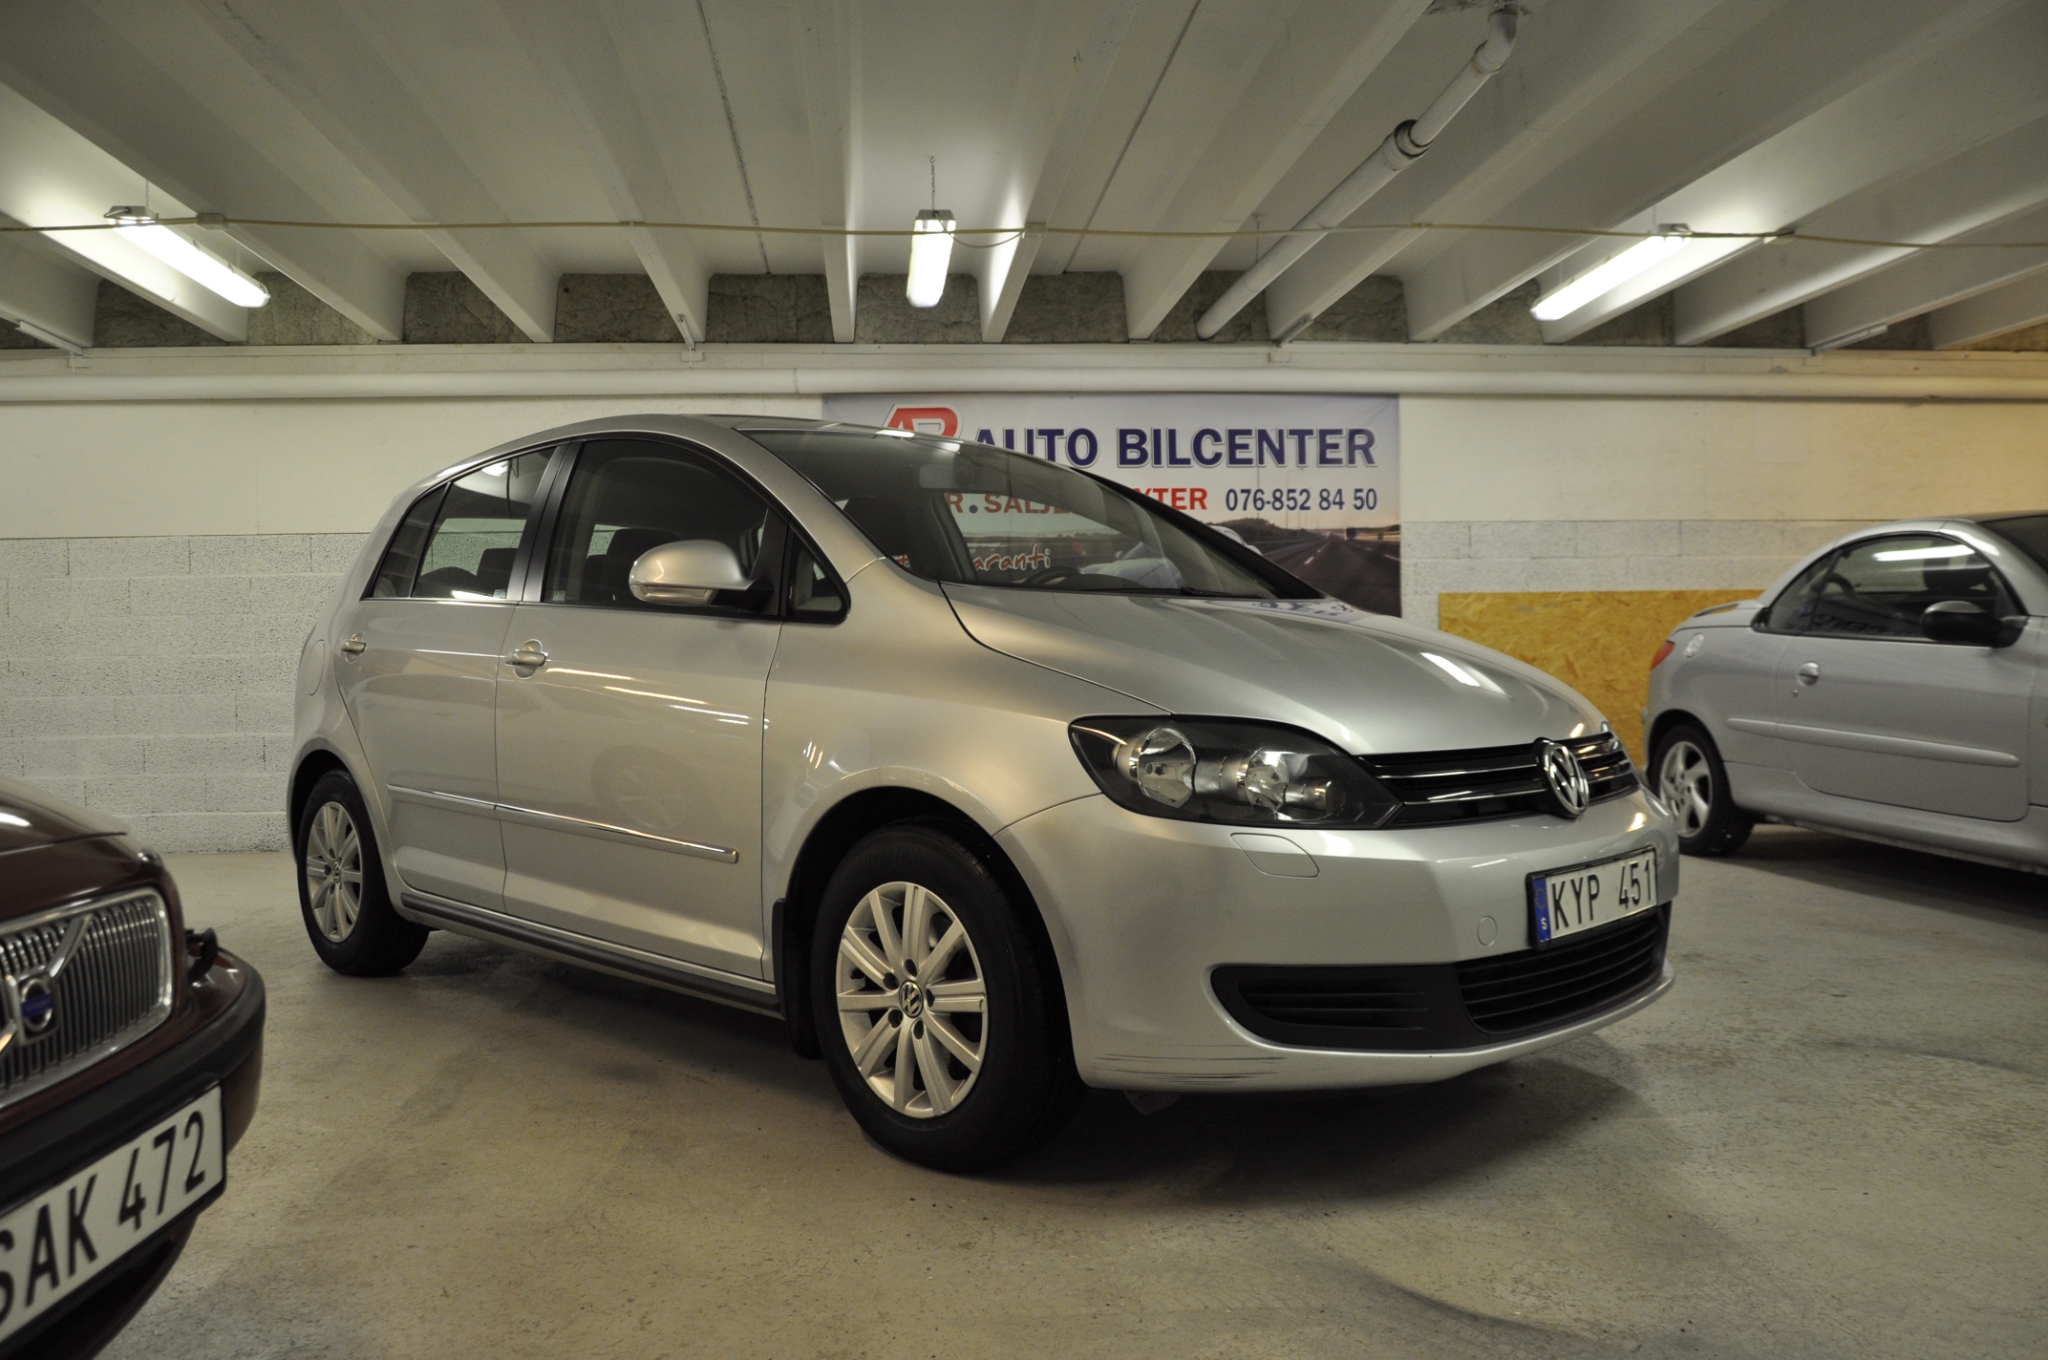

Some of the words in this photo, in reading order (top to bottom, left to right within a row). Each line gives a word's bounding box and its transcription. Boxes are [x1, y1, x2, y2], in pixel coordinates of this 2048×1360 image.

[1116, 427, 1377, 467] BILCENTER
[1225, 487, 1311, 512] 076-852
[1317, 488, 1346, 511] 84
[1352, 488, 1379, 511] 50
[1552, 874, 1600, 930] KYP
[1618, 859, 1652, 910] 451
[118, 1111, 205, 1232] 472
